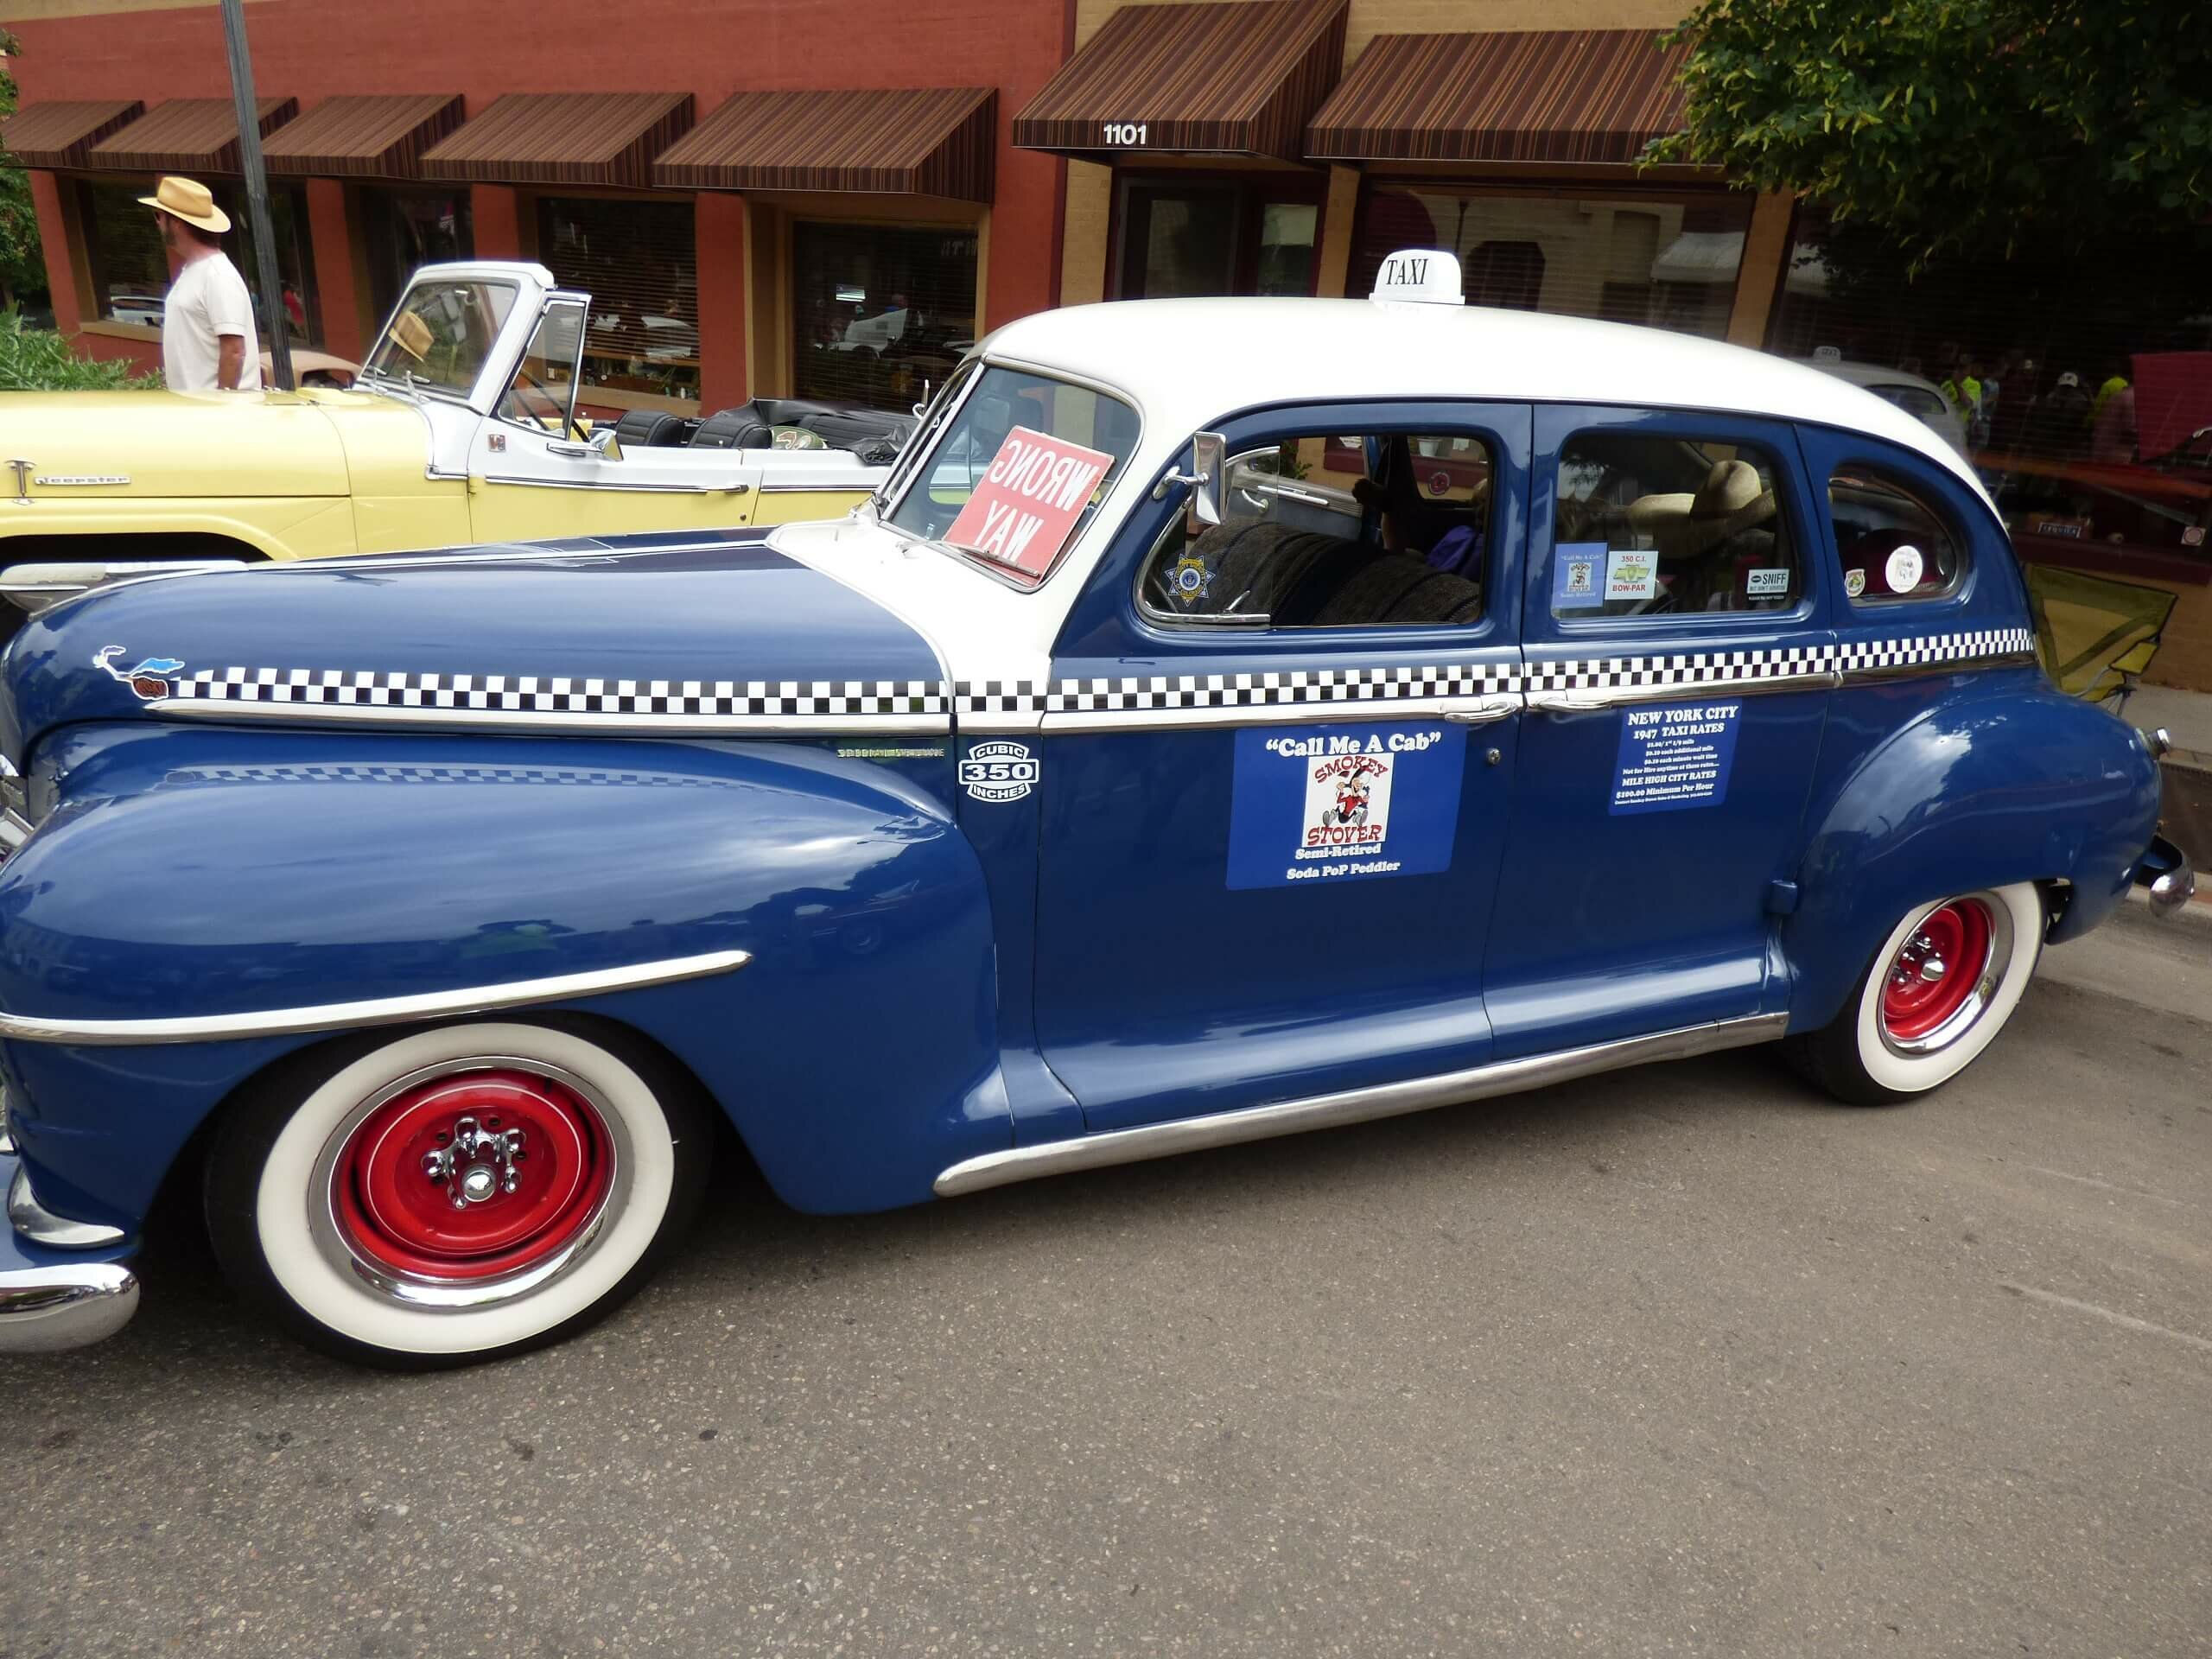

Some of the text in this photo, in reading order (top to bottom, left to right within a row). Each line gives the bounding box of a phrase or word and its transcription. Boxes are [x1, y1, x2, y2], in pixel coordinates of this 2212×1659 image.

[1103, 124, 1147, 145] 1101
[1385, 258, 1429, 285] TAXI
[1763, 574, 1787, 585] SNIFF
[1628, 706, 1739, 726] NEW YORK CITY
[1633, 722, 1725, 740] 1947 TAXI RATES
[976, 745, 1024, 758] CUBIC
[1329, 735, 1360, 755] Me
[1364, 734, 1383, 753] A
[964, 763, 1033, 781] 350
[1314, 755, 1389, 784] SMOKEY
[1622, 770, 1717, 786] MILE HIGH CITY RATES
[973, 784, 1025, 799] INCHES
[1616, 790, 1645, 799] $100.00
[1646, 786, 1681, 796] Minimum
[1306, 824, 1382, 846] STOVER
[1294, 843, 1382, 860] Semi-Retired
[1286, 861, 1401, 880] Soda PoP Peddler
